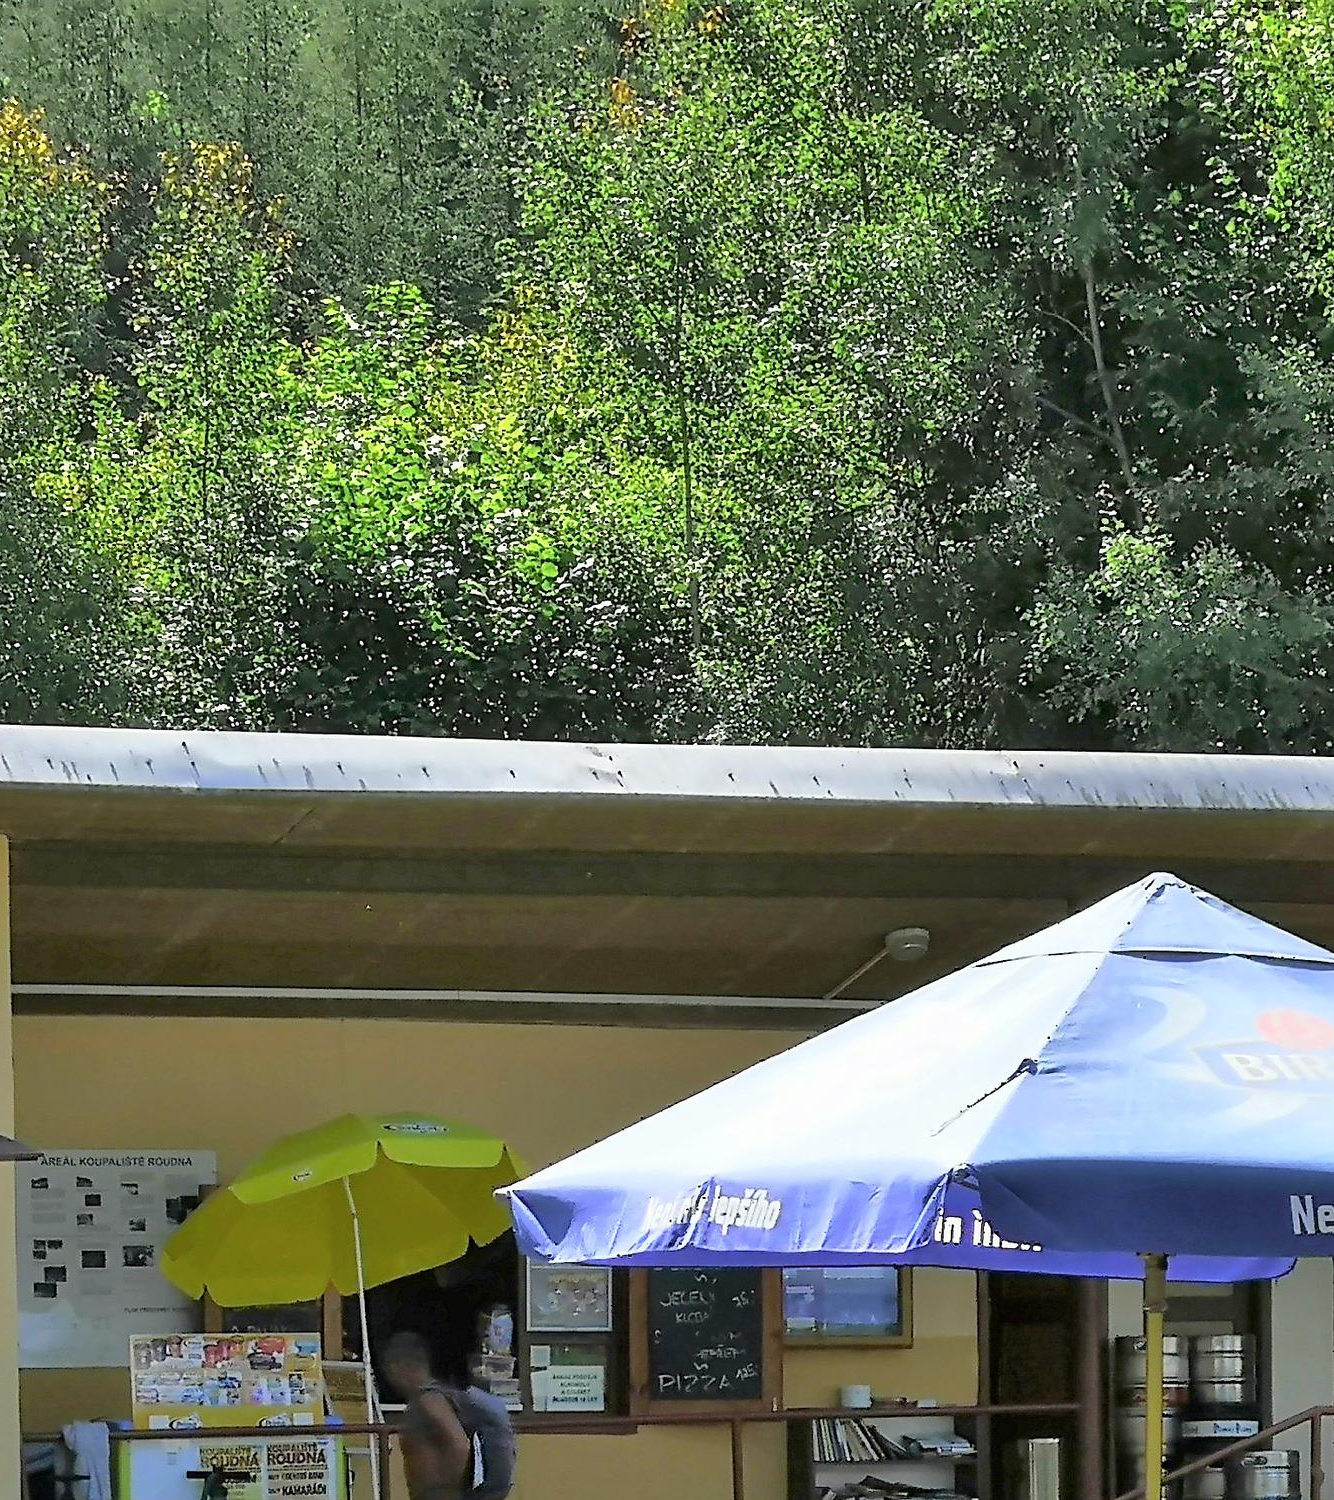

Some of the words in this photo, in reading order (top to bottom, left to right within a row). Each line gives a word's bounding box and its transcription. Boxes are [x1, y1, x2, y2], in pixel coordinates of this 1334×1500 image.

[707, 1184, 782, 1237] lepšího
[657, 1373, 734, 1393] PIZZA
[267, 1448, 327, 1466] ROUDNÁ
